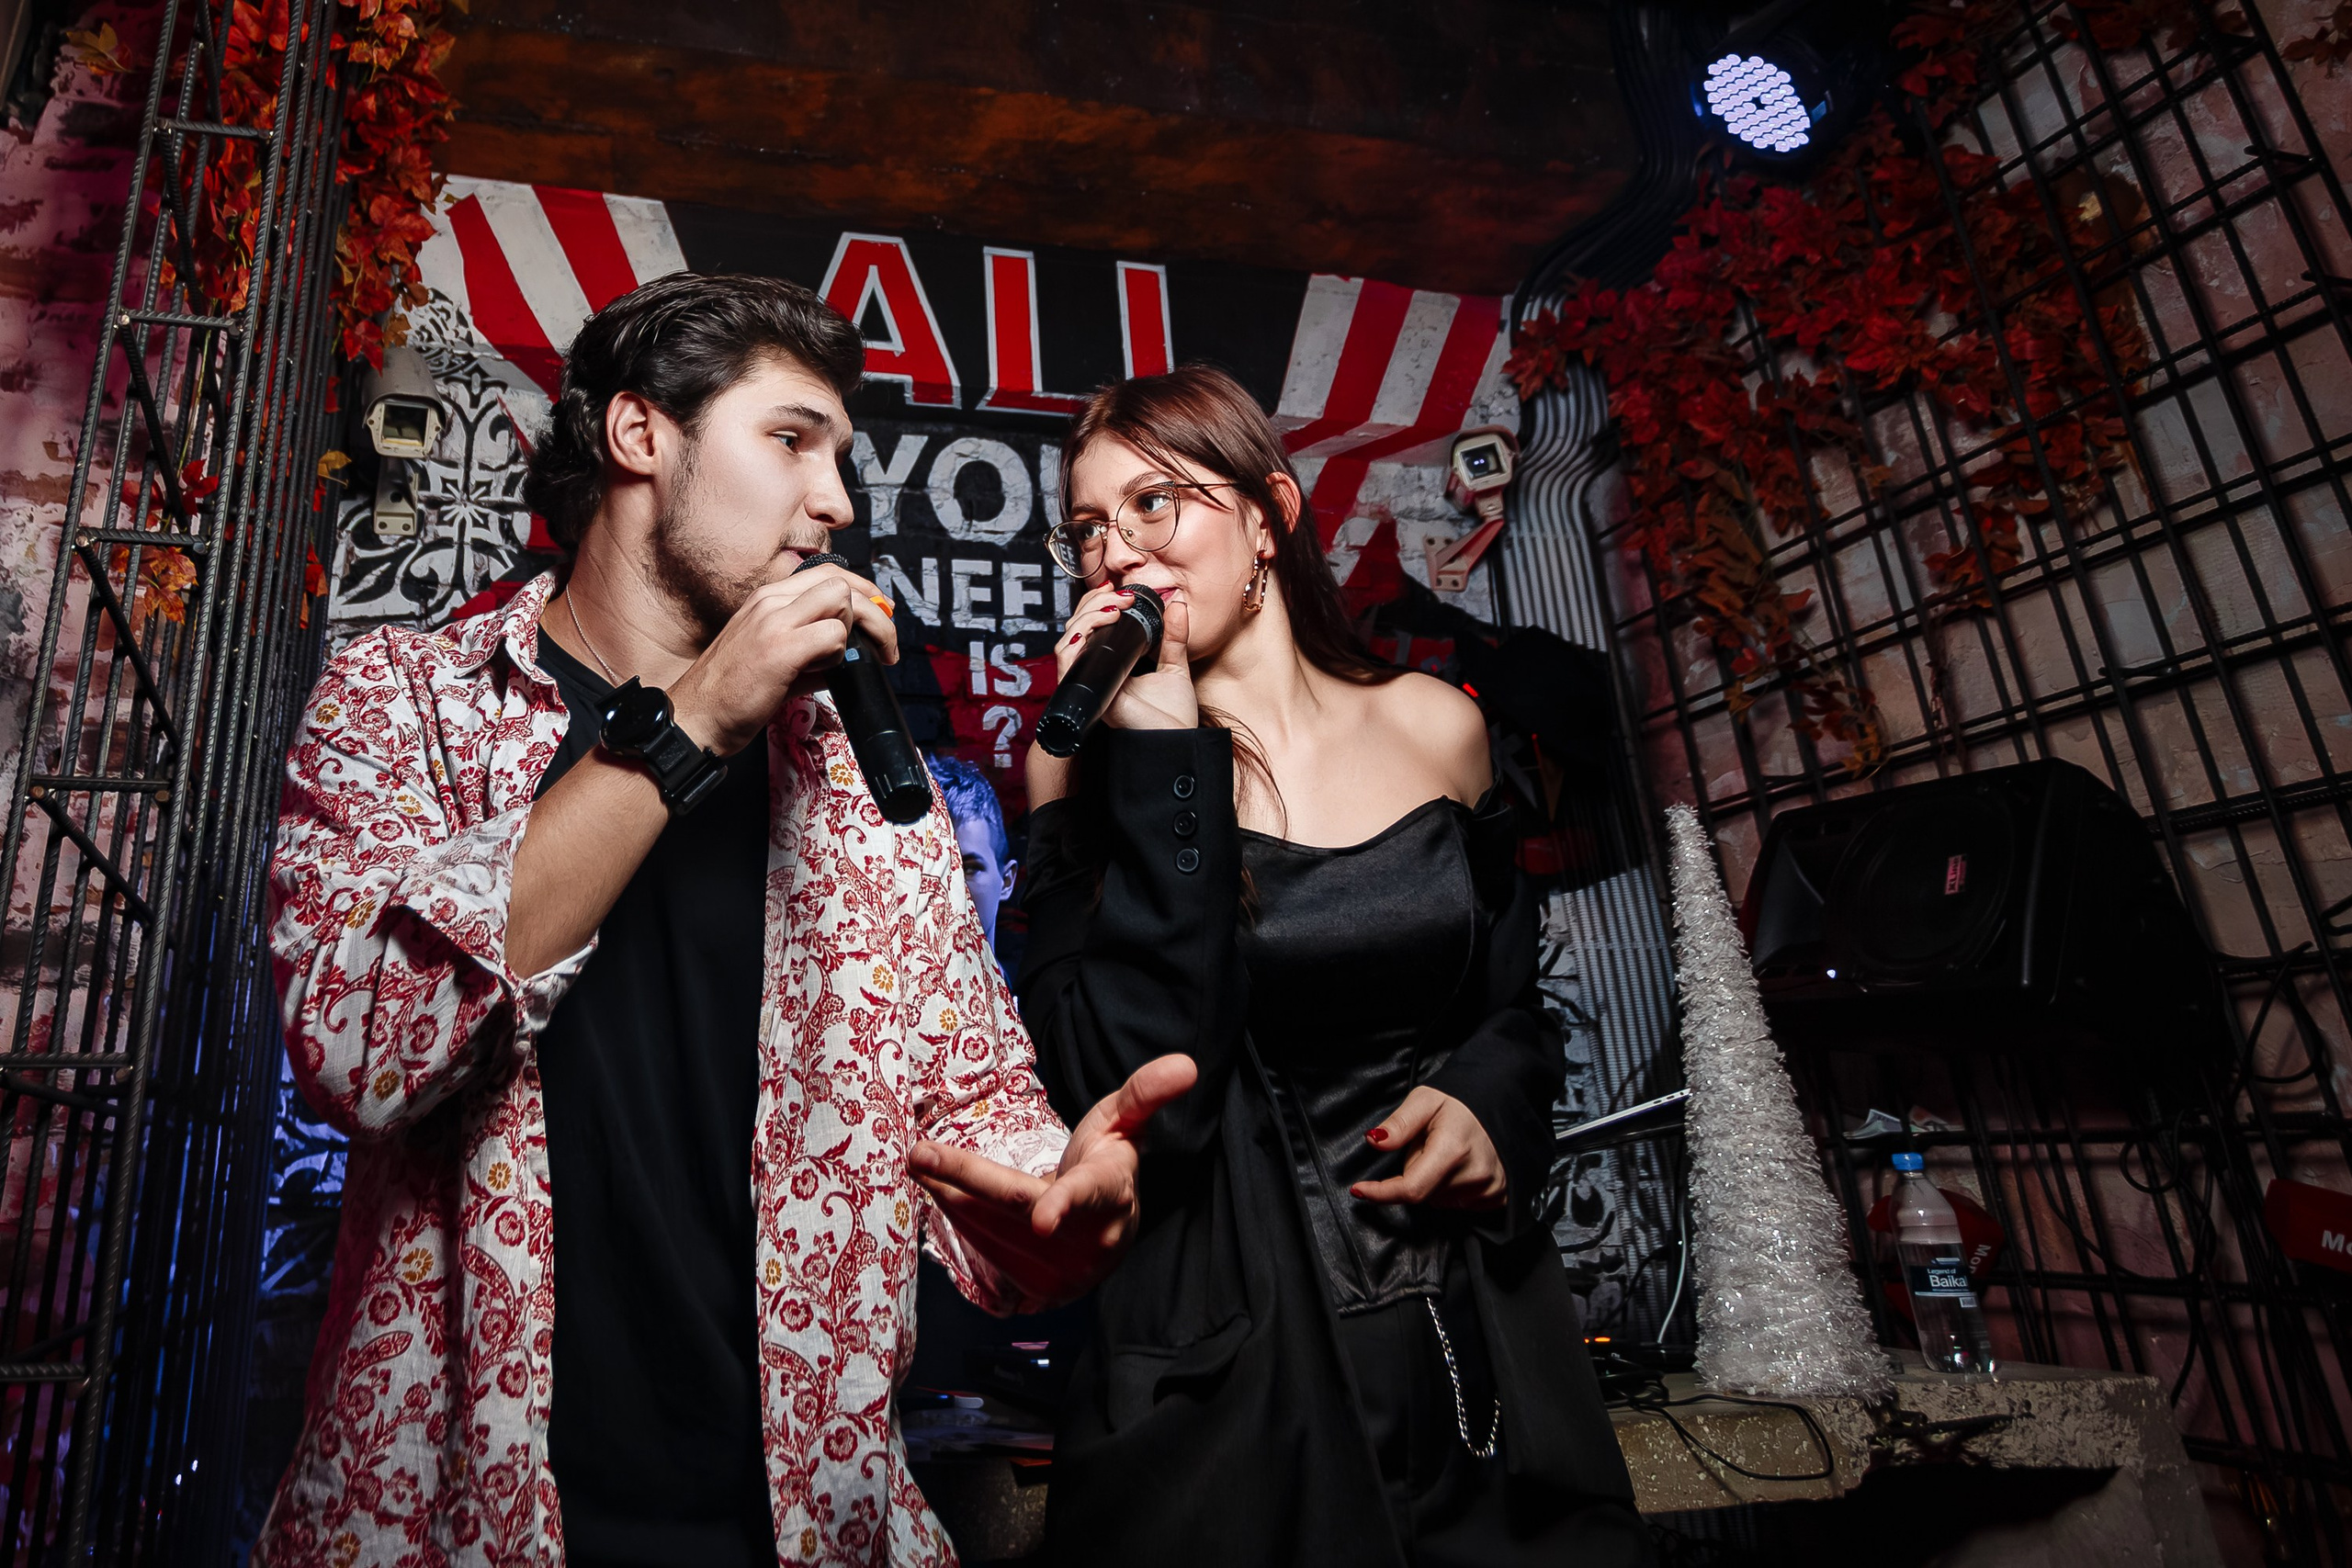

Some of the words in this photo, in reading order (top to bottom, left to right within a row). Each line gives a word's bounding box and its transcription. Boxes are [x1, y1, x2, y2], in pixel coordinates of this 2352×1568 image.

[851, 431, 1062, 547] YO
[969, 640, 1033, 697] IS
[982, 705, 1023, 768] ?
